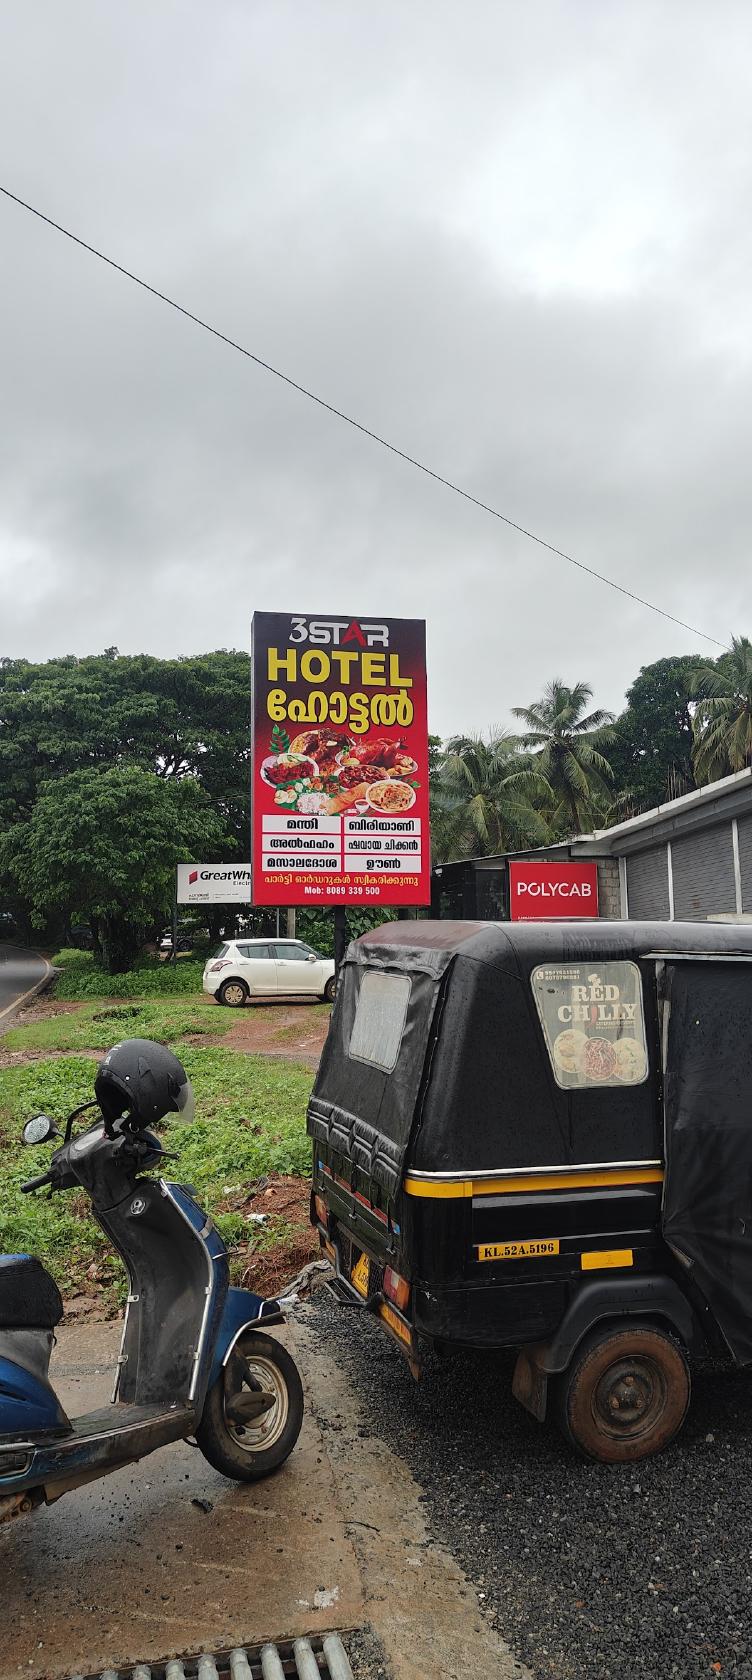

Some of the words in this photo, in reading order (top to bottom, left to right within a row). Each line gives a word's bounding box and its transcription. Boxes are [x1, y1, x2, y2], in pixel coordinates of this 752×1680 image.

[288, 617, 390, 647] 3STAR
[267, 647, 413, 687] HOTEL
[266, 688, 414, 734] ഹോട്ടൽ
[286, 817, 319, 830] മന്തി
[348, 819, 415, 832] ബിരിയാണി
[269, 837, 335, 849] അൽഫഹം
[348, 840, 382, 850] ഷവായ
[384, 838, 419, 850] ചിക്കൻ
[266, 857, 338, 868] മസാലദോശ
[366, 858, 401, 870] ഊൺ
[200, 870, 252, 881] GreatWh
[264, 873, 293, 885] പാർട്ടി
[304, 886, 324, 895] Mob:
[326, 886, 346, 895] 8089
[348, 887, 363, 895] 339
[365, 887, 380, 895] 500
[517, 881, 592, 897] POLYCAB
[571, 984, 620, 1002] RED
[557, 1003, 639, 1023] CHILLY
[484, 1243, 554, 1257] KL.52A.5196
